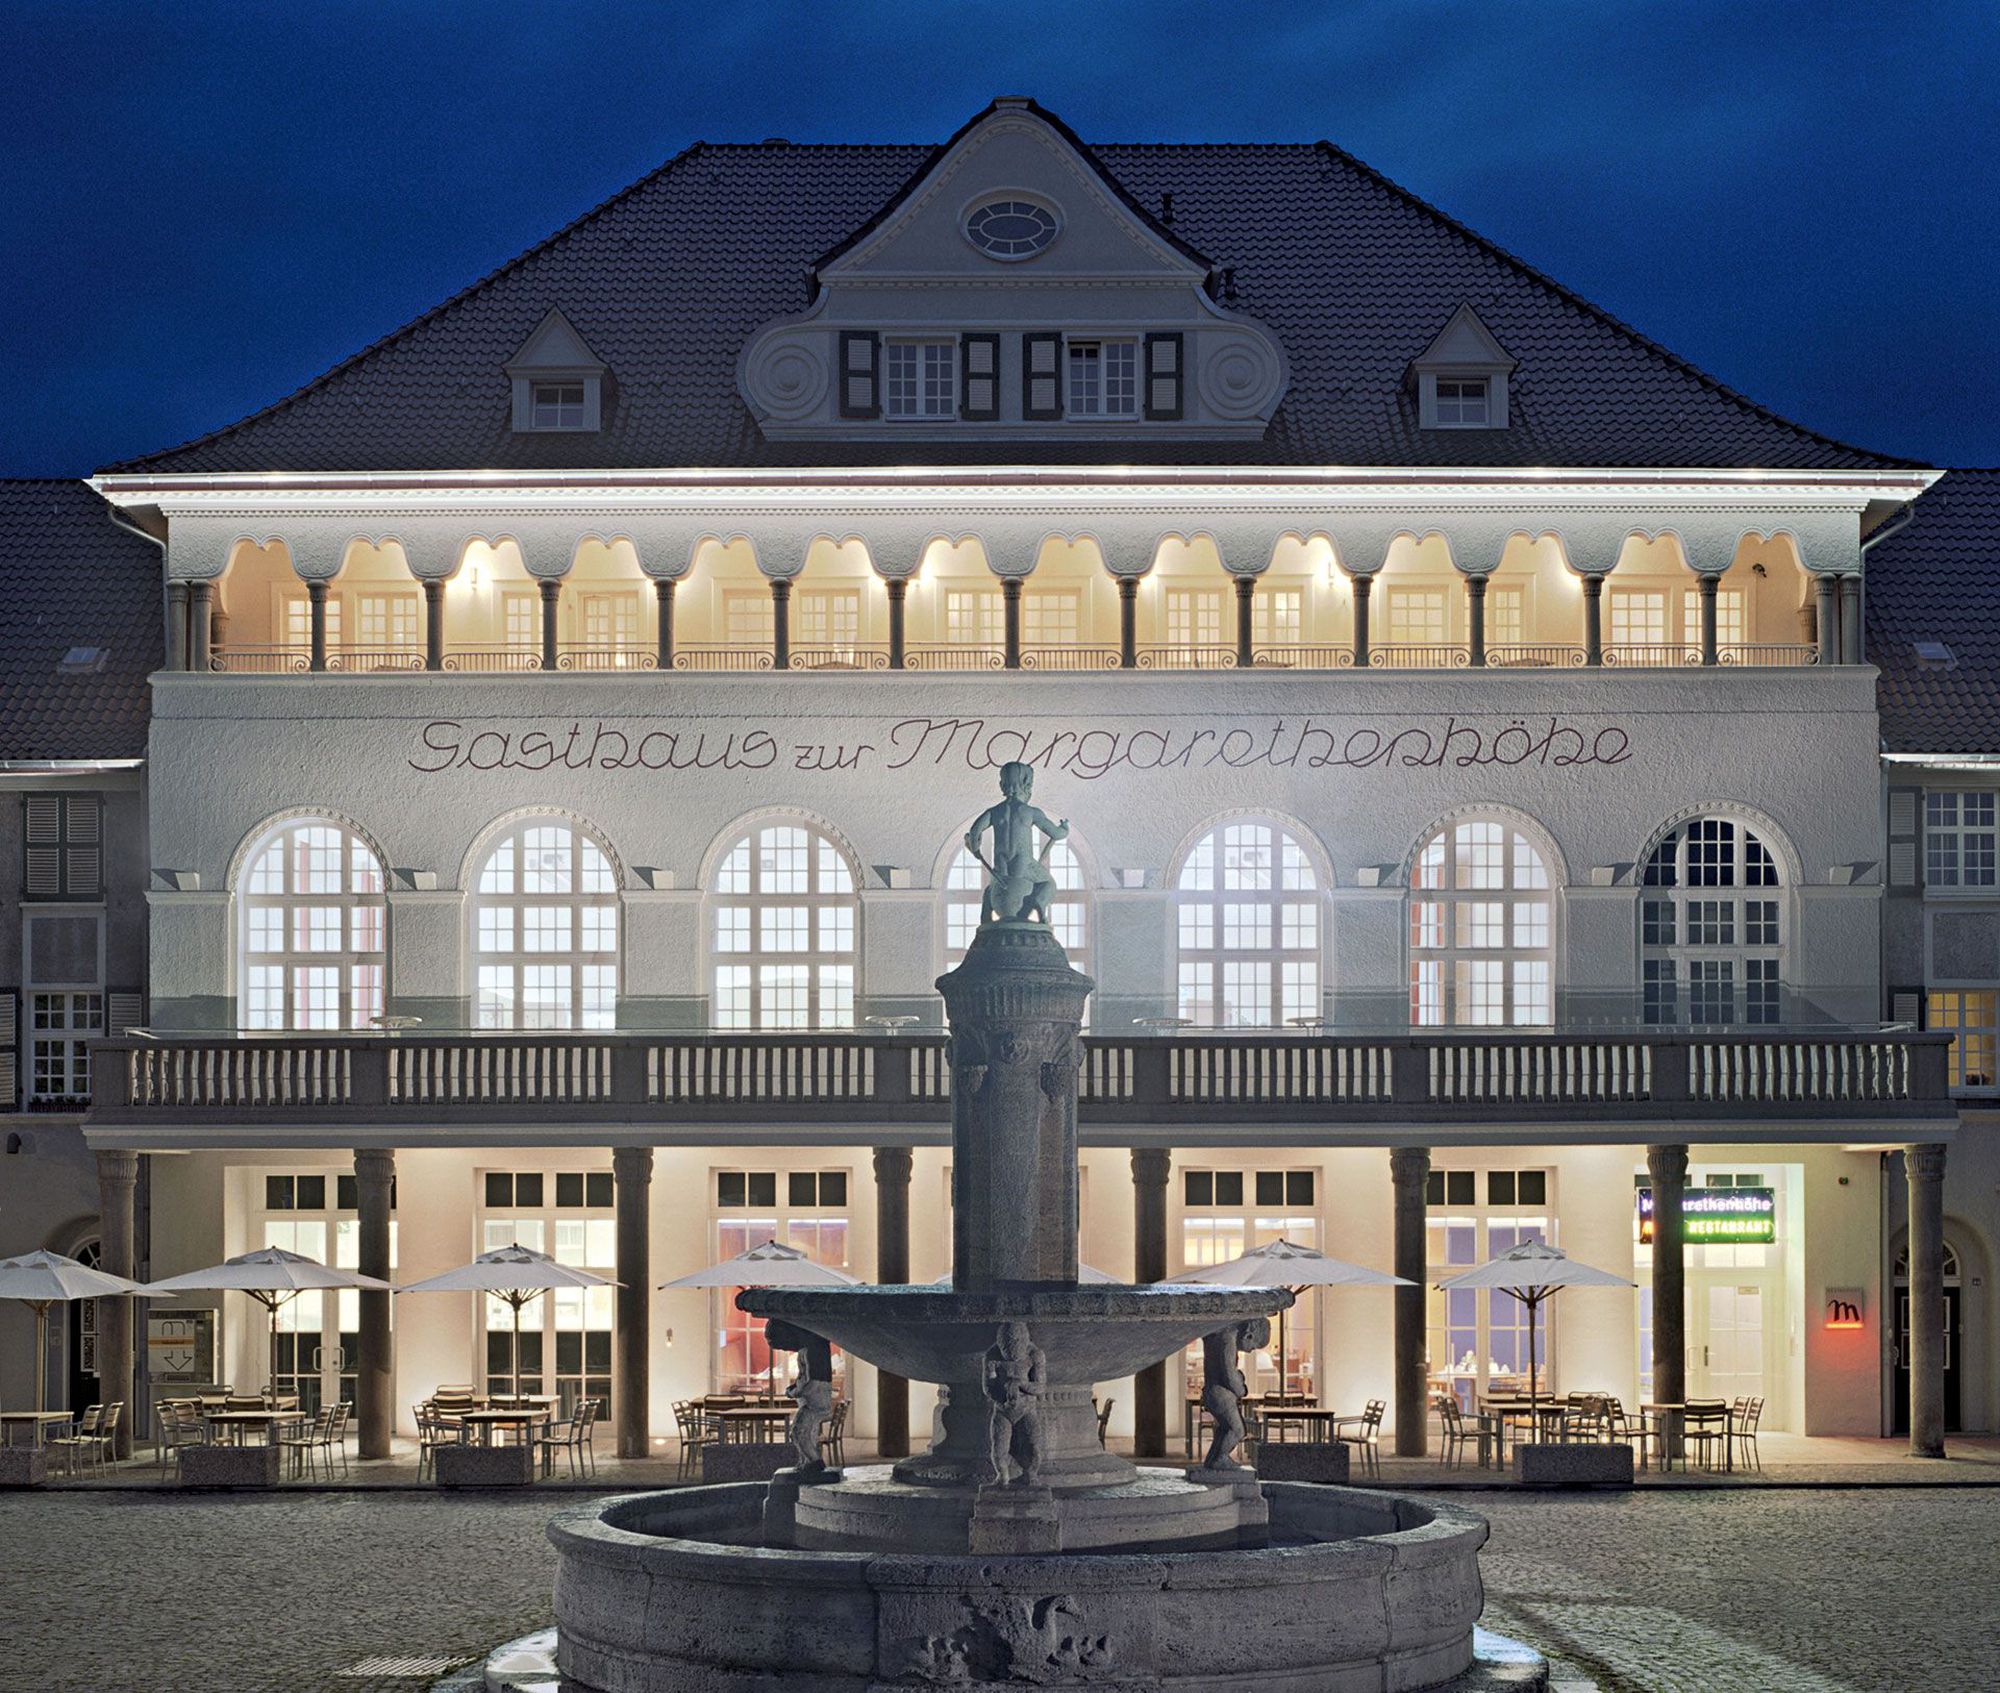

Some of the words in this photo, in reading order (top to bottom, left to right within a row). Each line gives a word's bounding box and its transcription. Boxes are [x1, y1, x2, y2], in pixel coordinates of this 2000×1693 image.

[408, 721, 777, 772] Gasthaus
[795, 740, 876, 771] zur
[886, 717, 1634, 780] Margarethenhöhe
[1689, 1220, 1770, 1234] RESTAURANT
